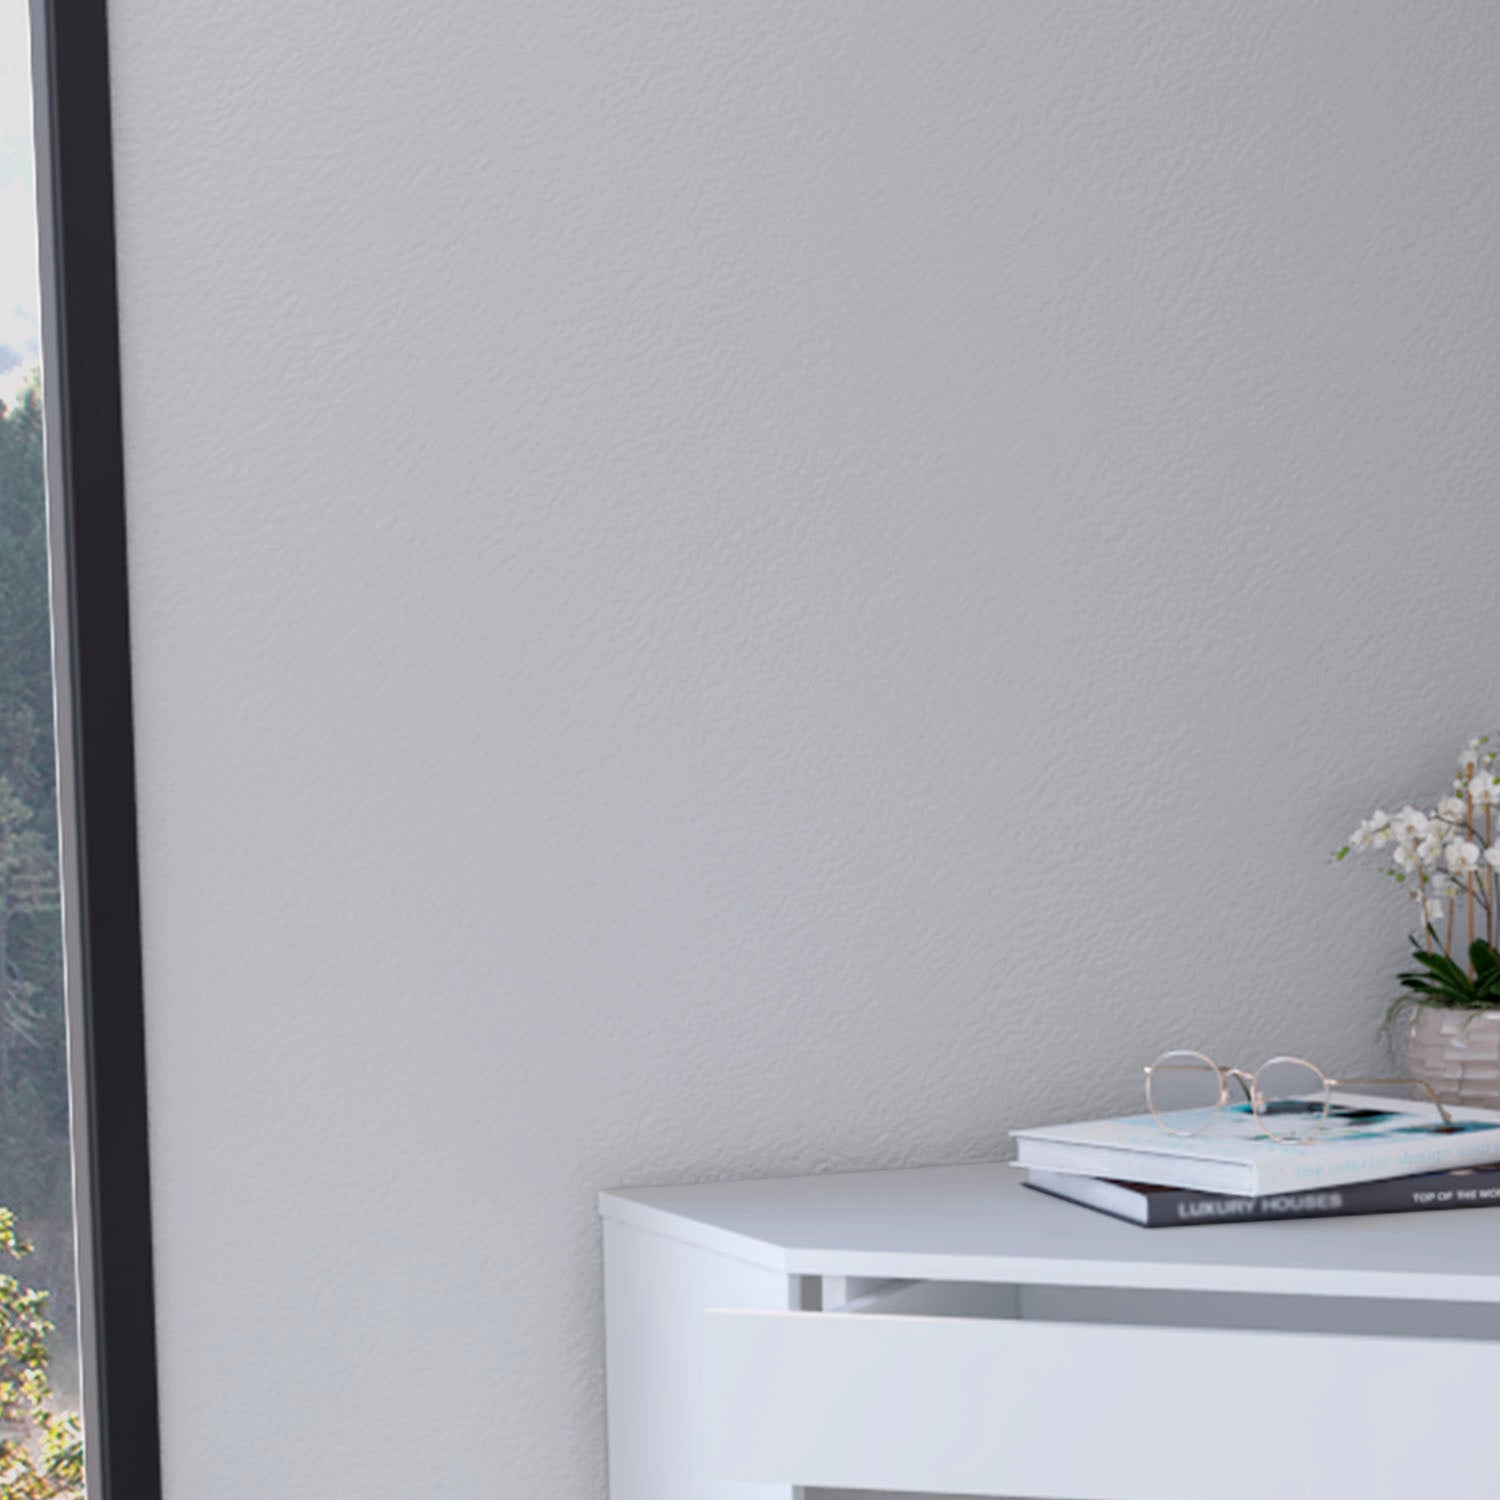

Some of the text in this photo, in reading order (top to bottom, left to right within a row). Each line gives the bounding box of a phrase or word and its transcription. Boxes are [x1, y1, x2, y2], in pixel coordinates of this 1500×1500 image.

[1178, 1193, 1343, 1219] LUXURY HOUSES
[1413, 1191, 1435, 1204] TOP
[1437, 1190, 1453, 1202] OF
[1456, 1189, 1477, 1201] THE
